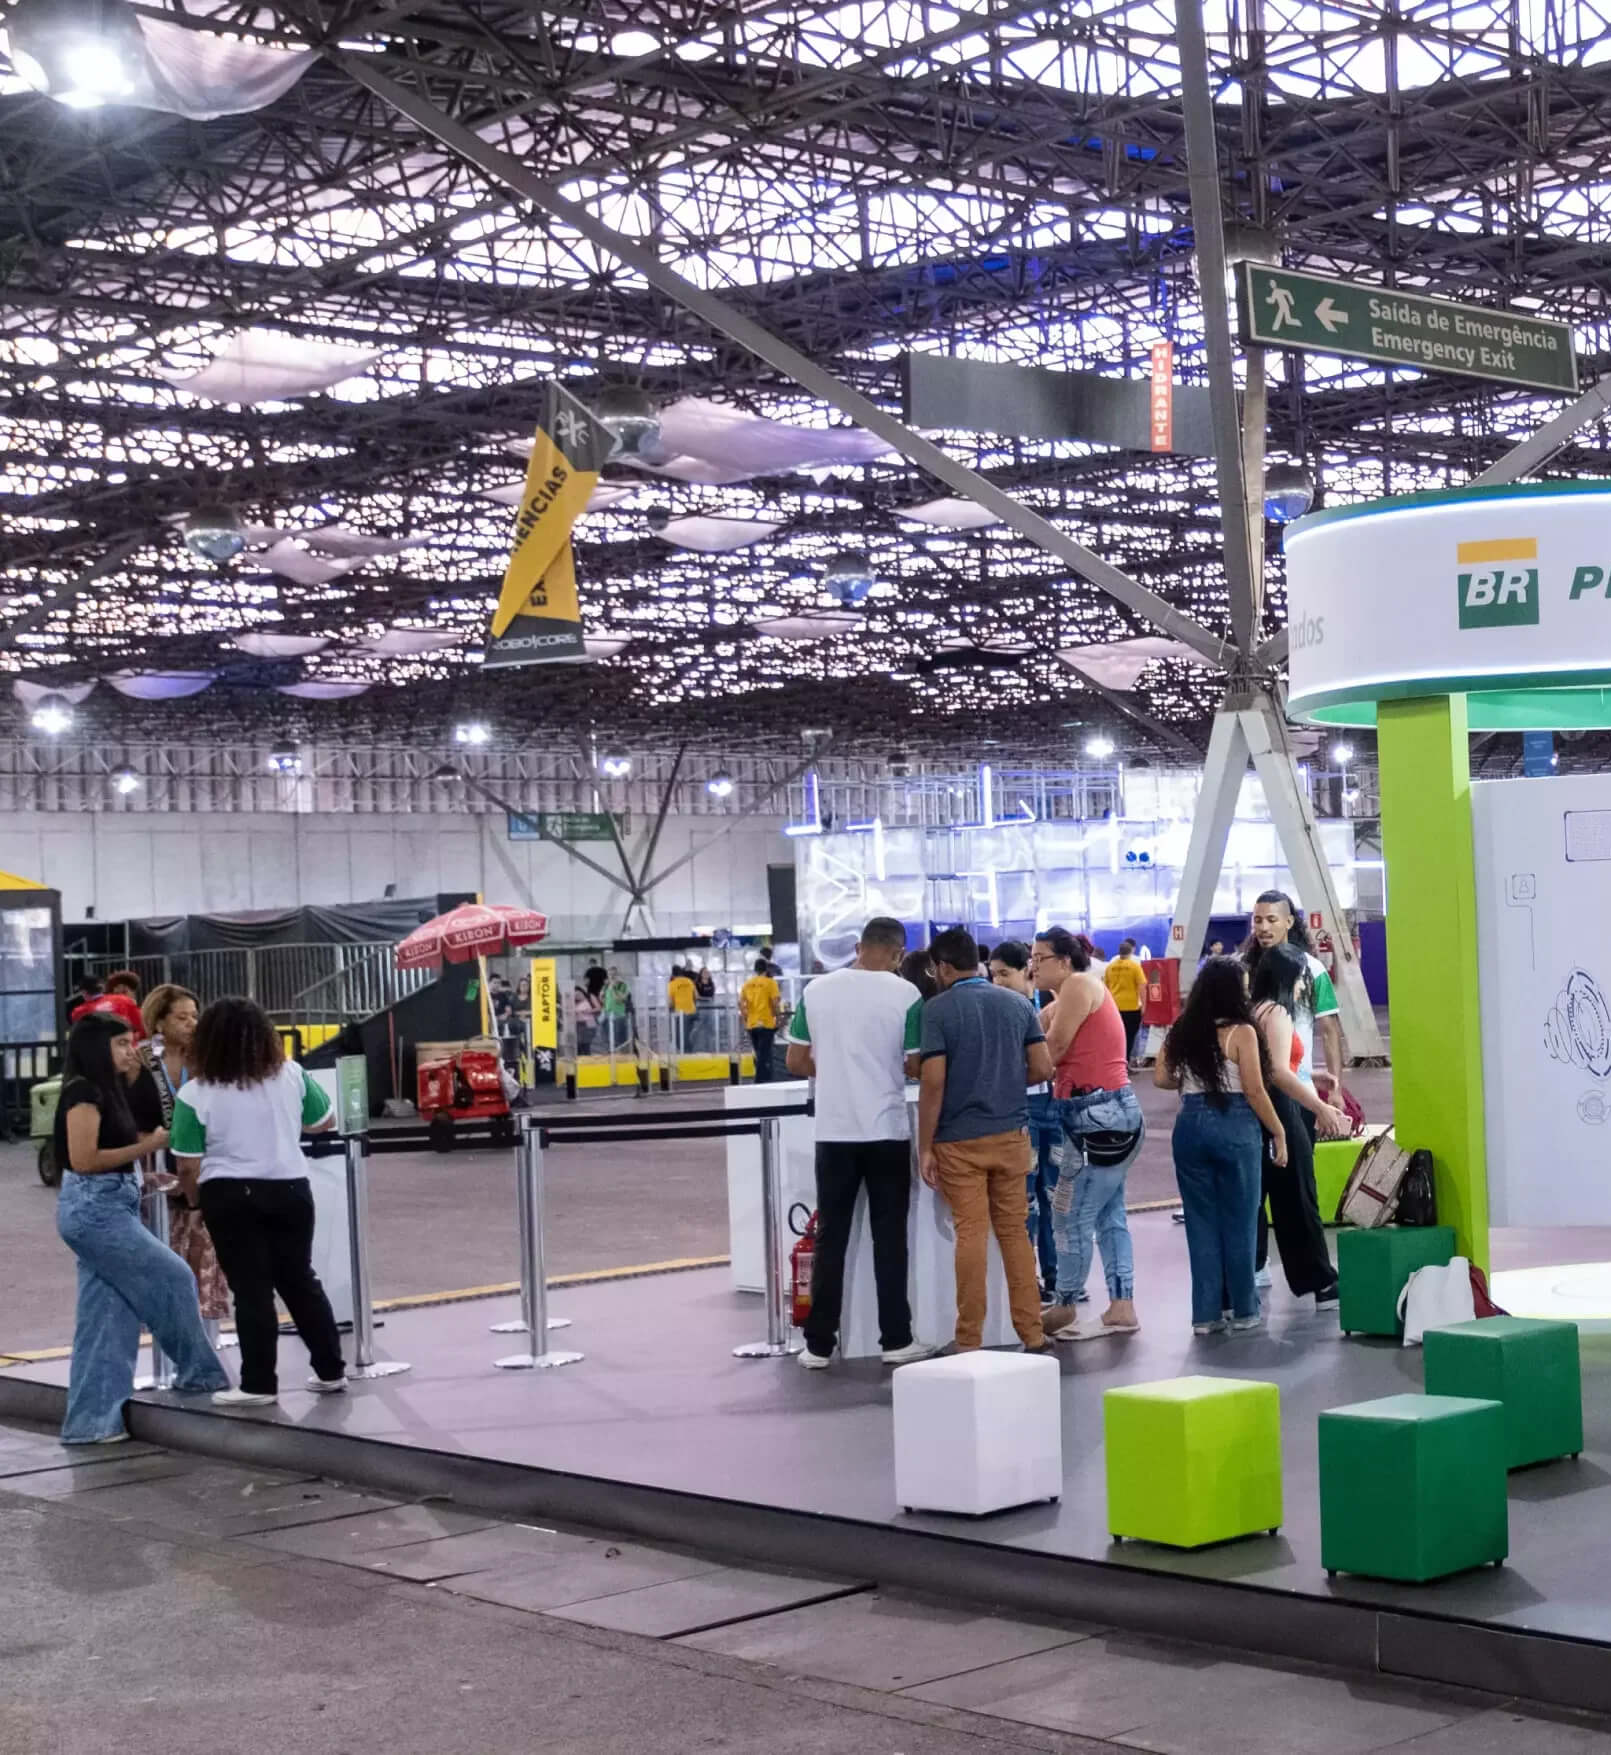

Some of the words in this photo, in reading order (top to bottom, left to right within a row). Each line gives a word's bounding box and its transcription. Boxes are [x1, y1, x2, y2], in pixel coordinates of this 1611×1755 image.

[1368, 298, 1422, 327] Saída
[1426, 309, 1449, 331] de
[1455, 315, 1558, 350] Emergência
[1371, 326, 1475, 369] Emergency
[1479, 346, 1517, 371] Exit
[1153, 346, 1169, 447] HIDRANTE
[1464, 569, 1530, 607] BR
[454, 926, 494, 944] KIBON
[514, 919, 543, 931] KIBON
[404, 942, 433, 958] KIBON
[541, 975, 551, 1023] RAPTOR
